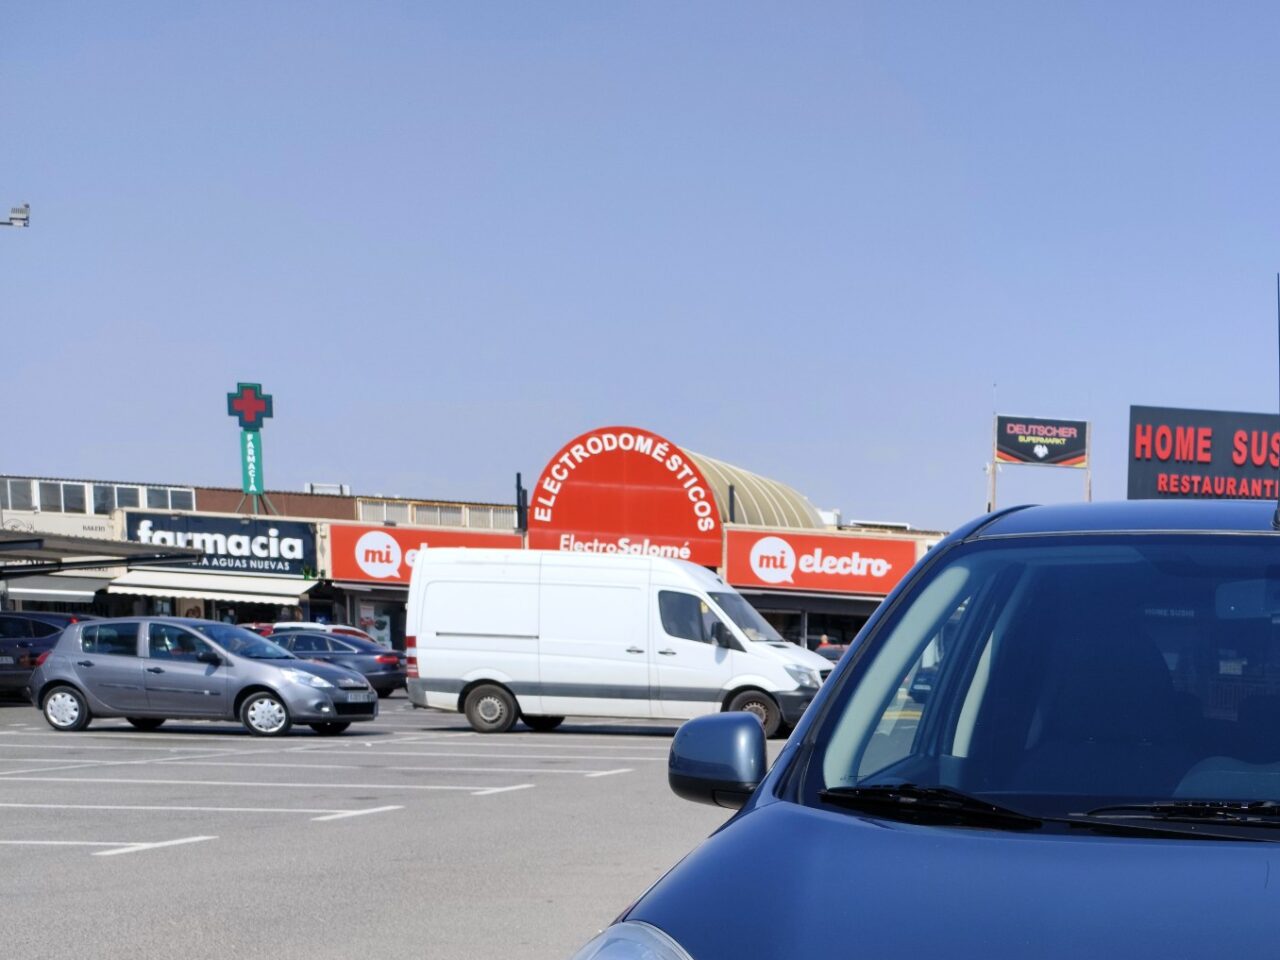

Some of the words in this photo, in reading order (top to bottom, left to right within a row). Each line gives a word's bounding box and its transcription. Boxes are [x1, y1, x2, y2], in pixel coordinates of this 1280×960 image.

[1006, 422, 1078, 438] DEUTSCHER
[1134, 424, 1212, 462] HOME
[246, 433, 257, 492] FARMACIA
[534, 432, 715, 532] ELECTRODOMÉSTICOS
[137, 520, 304, 560] farmacia
[364, 545, 393, 564] mi
[211, 557, 247, 568] AGUAS
[249, 559, 290, 571] NUEVAS
[758, 550, 788, 570] mi
[798, 547, 892, 578] electro
